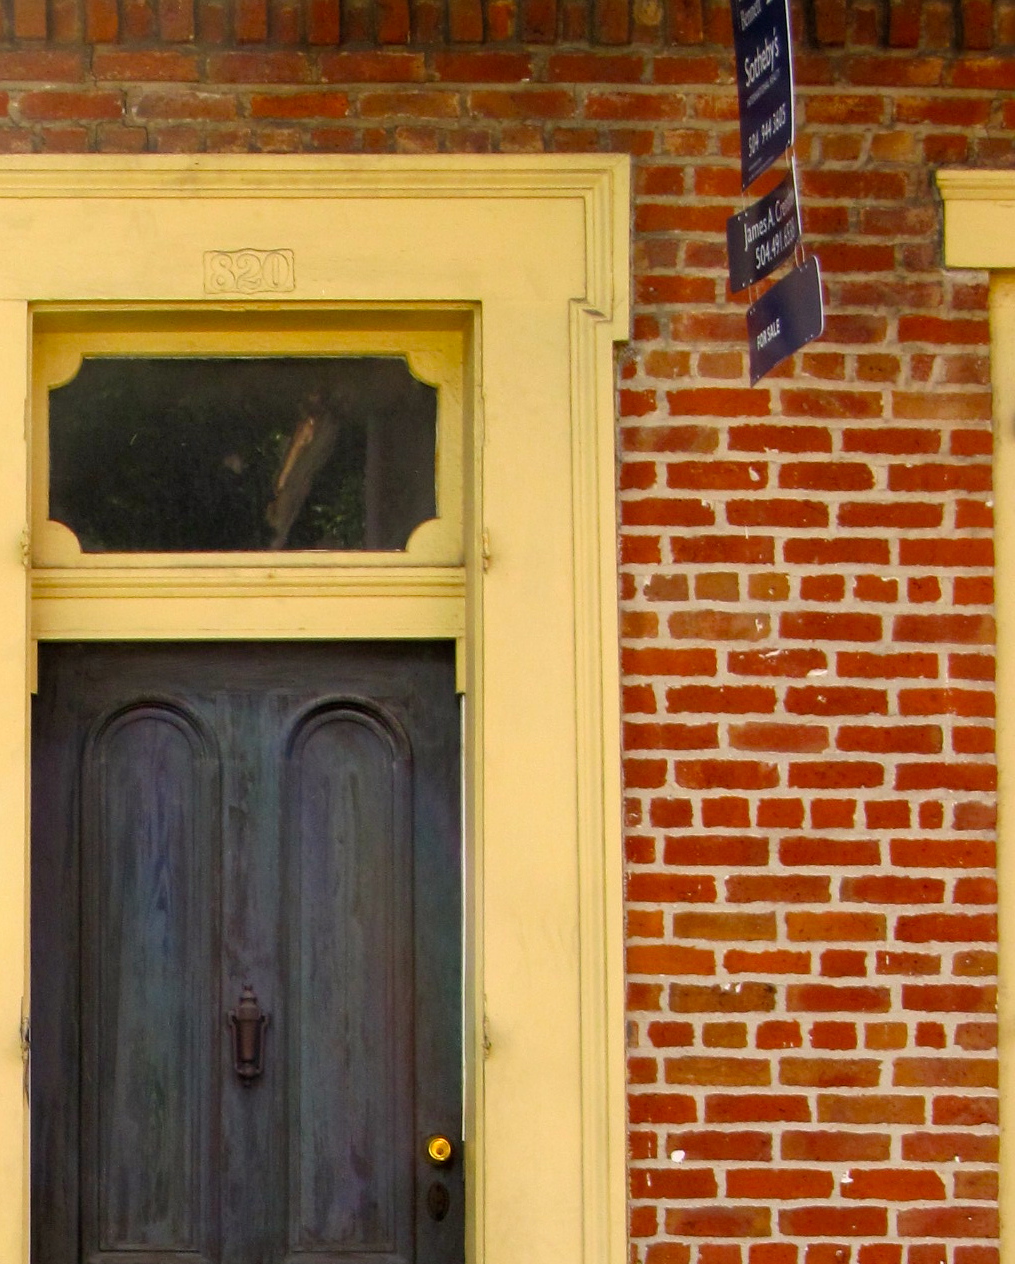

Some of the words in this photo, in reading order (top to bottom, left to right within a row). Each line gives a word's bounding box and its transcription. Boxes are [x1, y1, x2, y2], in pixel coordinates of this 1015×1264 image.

[744, 27, 779, 87] Sotheby's
[744, 218, 768, 252] James
[210, 252, 290, 291] 820
[757, 328, 767, 351] FOR
[767, 318, 780, 342] SALE
